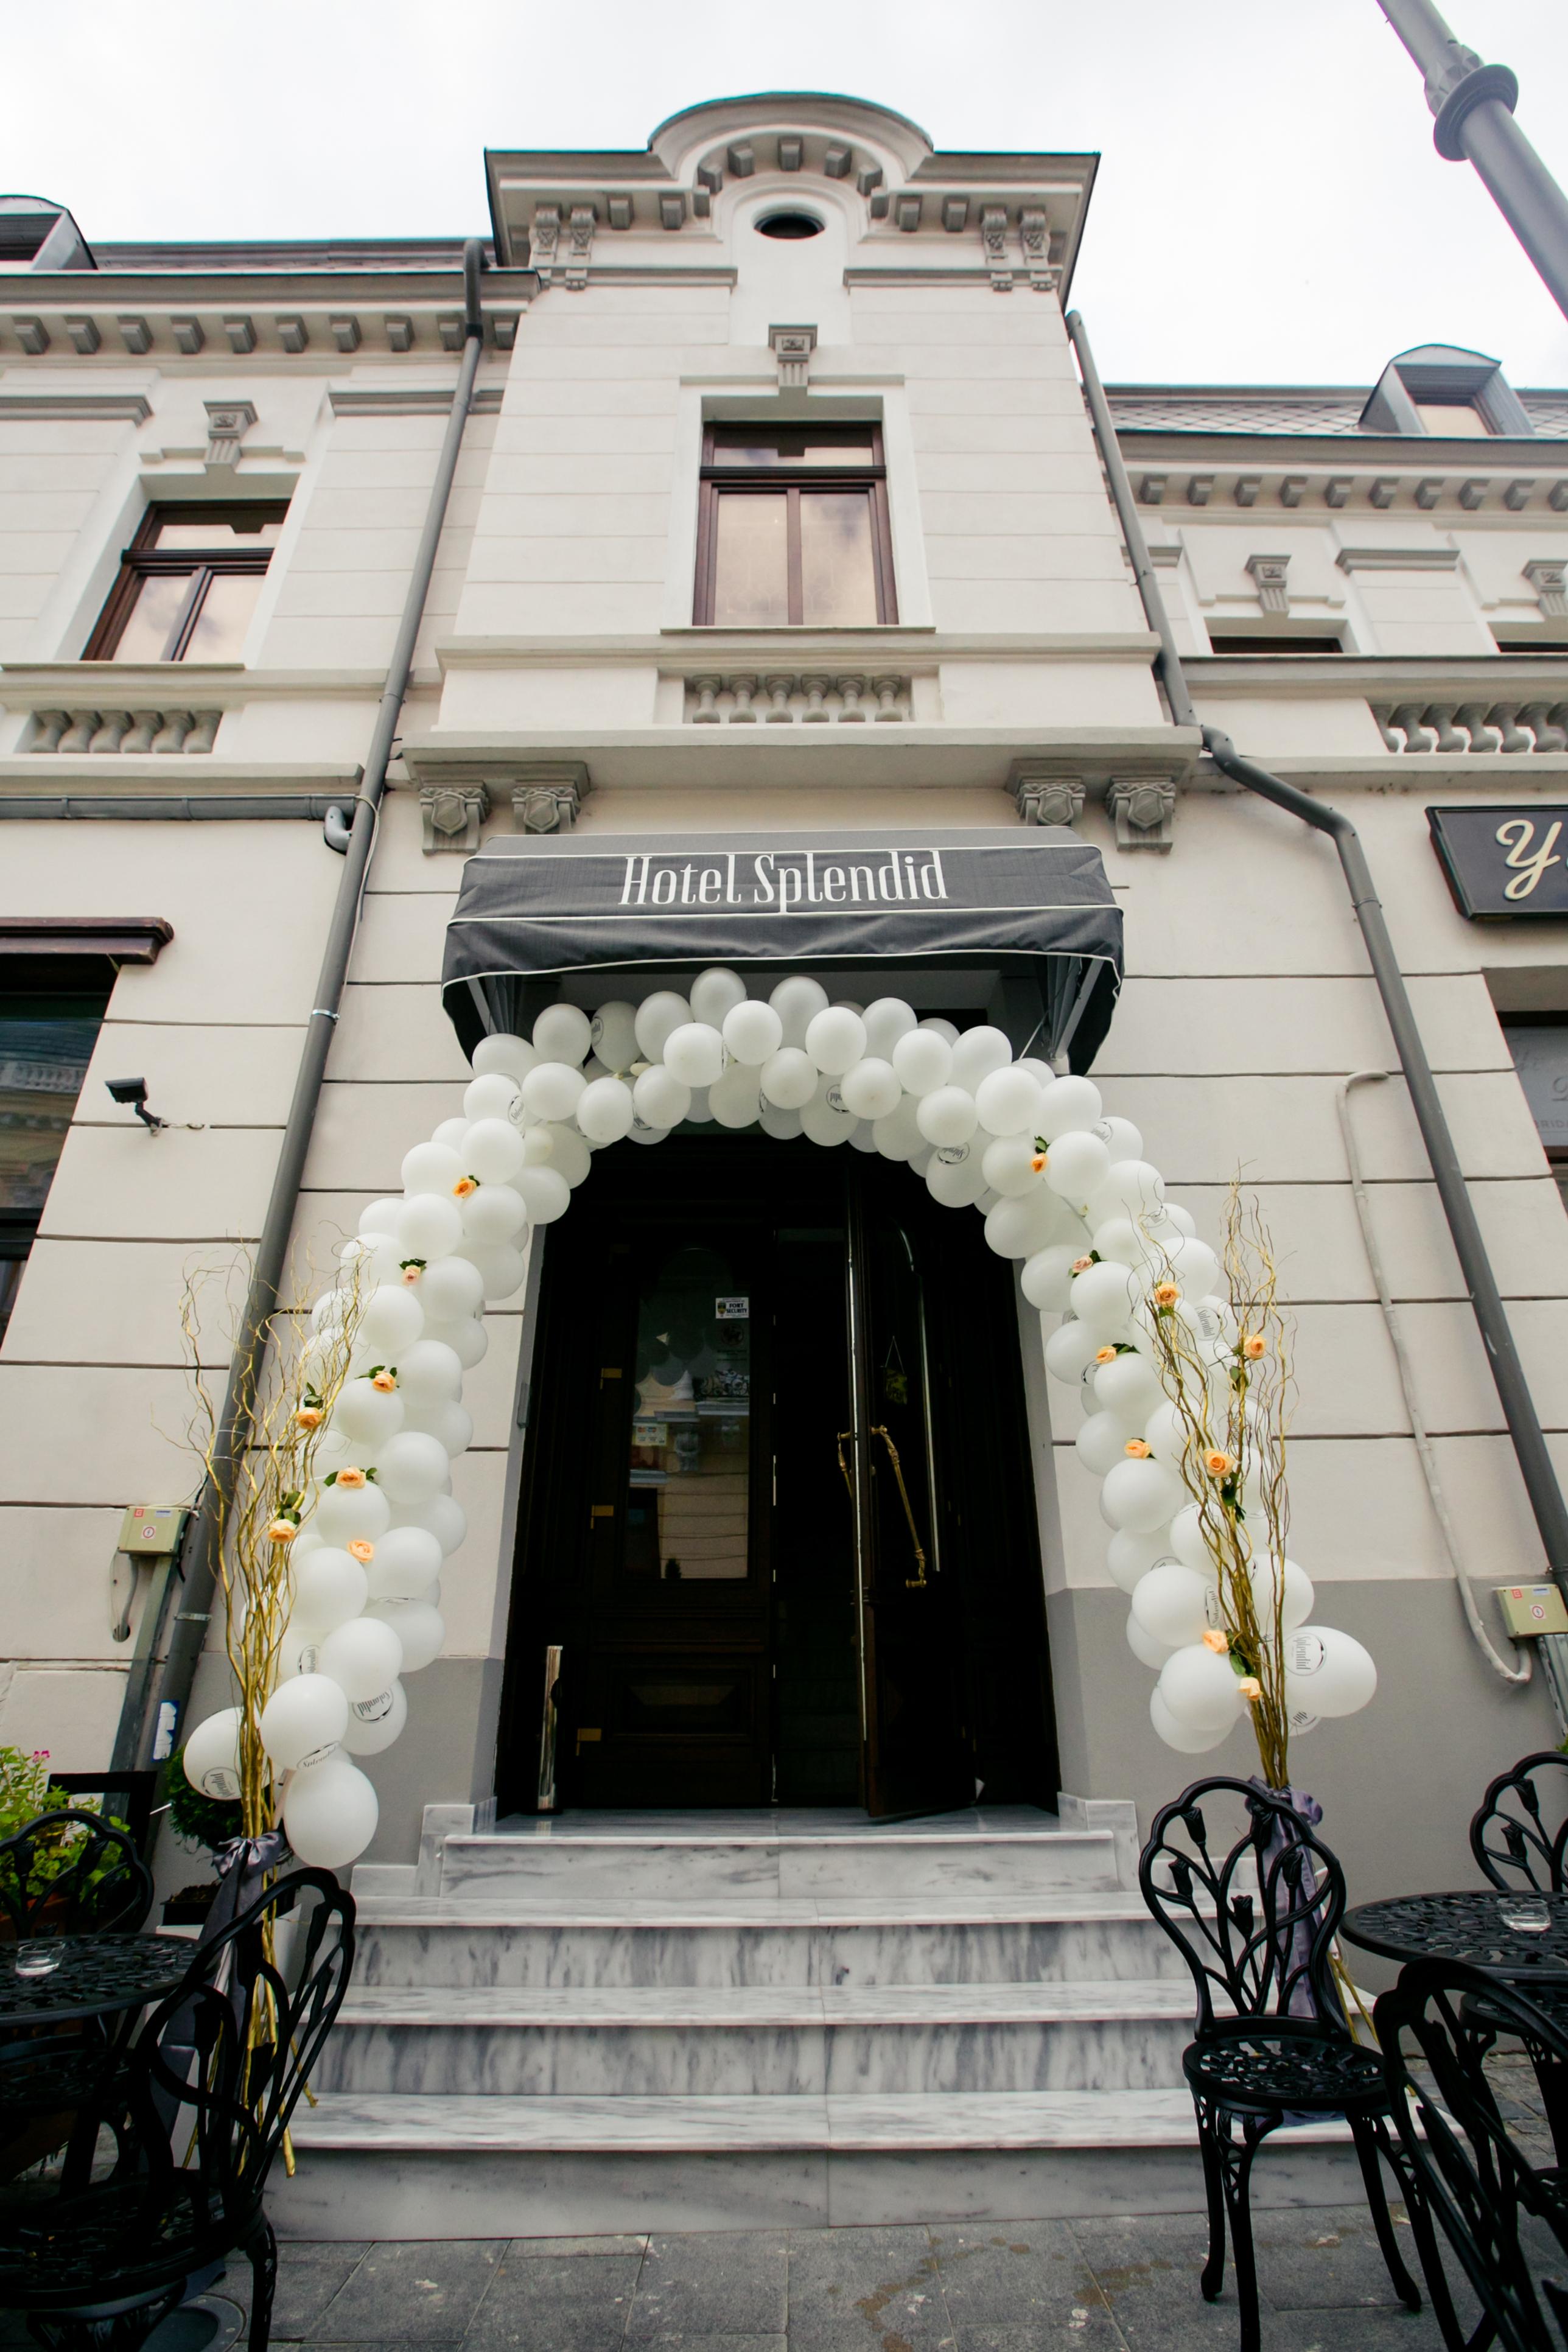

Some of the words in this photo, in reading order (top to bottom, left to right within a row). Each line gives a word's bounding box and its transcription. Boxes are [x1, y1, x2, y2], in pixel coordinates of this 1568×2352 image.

[1496, 819, 1568, 900] Y
[617, 853, 741, 905] Hotel
[754, 850, 949, 914] Splendid
[1197, 1309, 1216, 1337] Splendid
[1208, 1590, 1219, 1625] Splendid
[1292, 1636, 1311, 1670] Splendid
[357, 1691, 391, 1717] Splendid
[303, 1745, 337, 1768] Splendid
